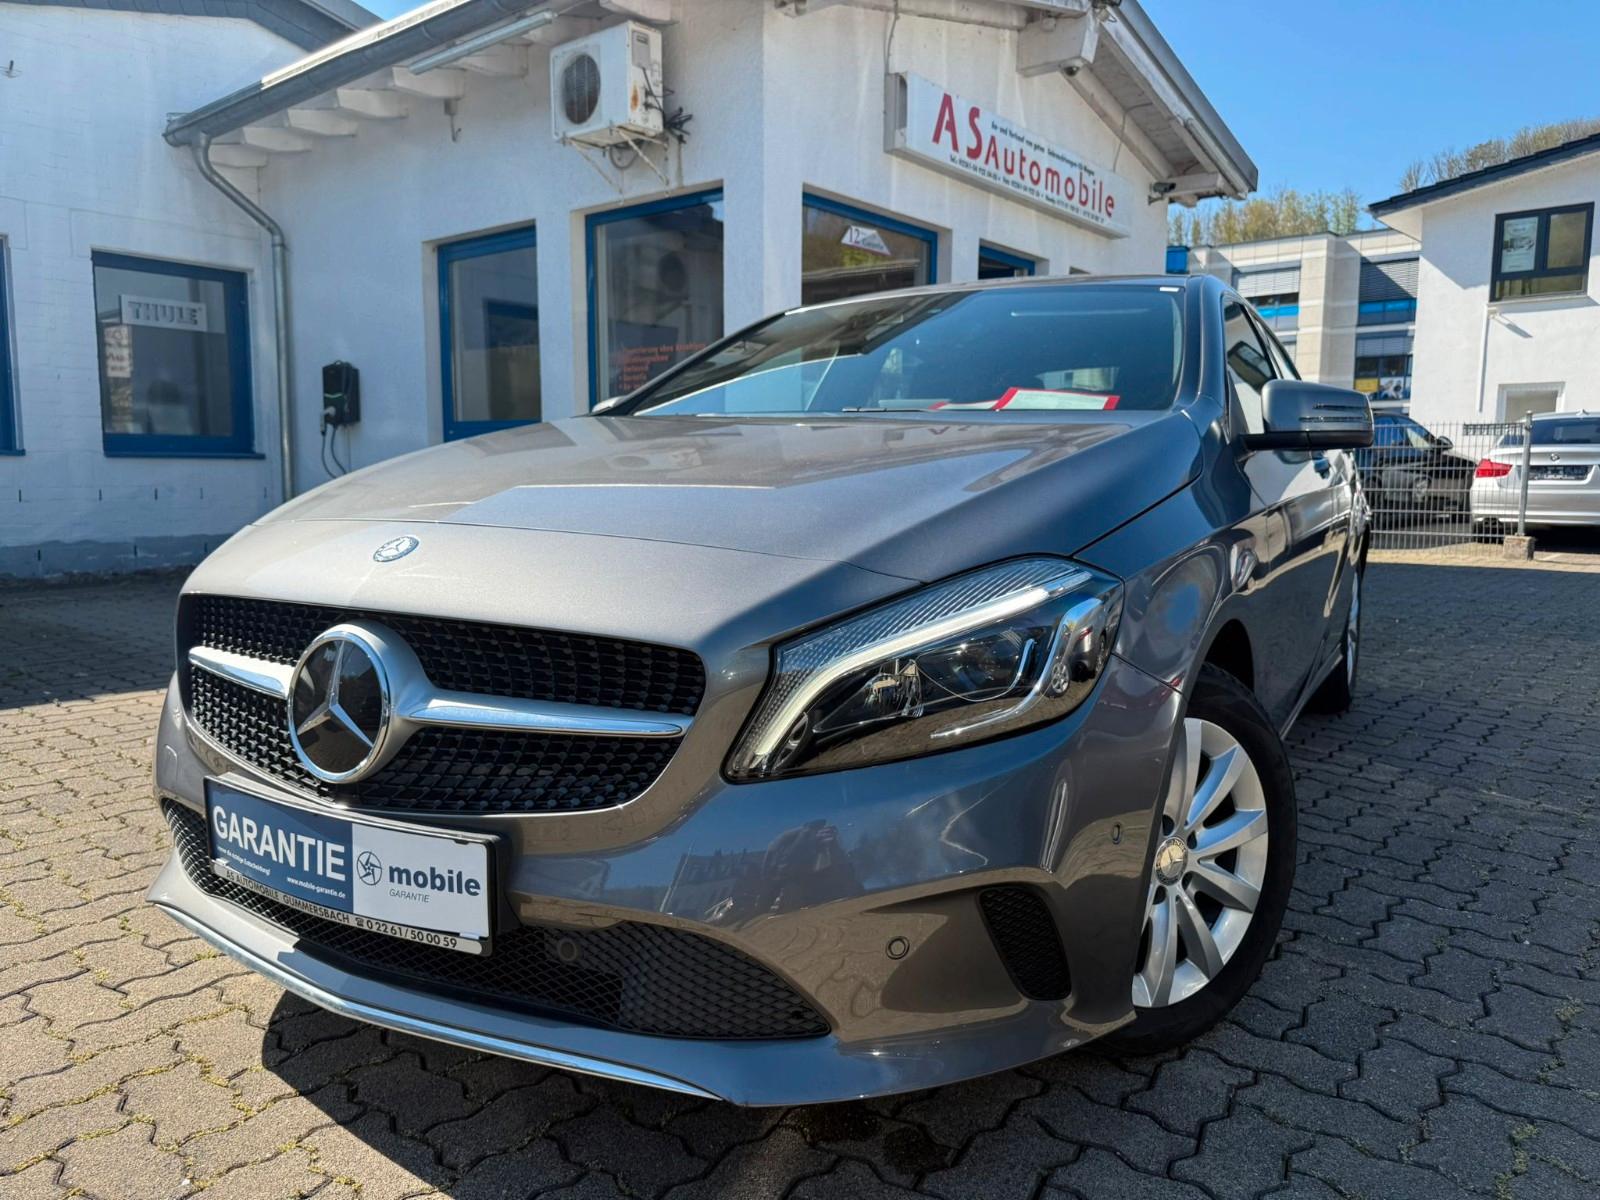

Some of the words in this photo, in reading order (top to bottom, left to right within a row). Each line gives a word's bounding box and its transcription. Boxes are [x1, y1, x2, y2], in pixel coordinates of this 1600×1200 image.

[984, 134, 1115, 218] Automobile
[213, 805, 346, 882] GARANTIE
[236, 874, 279, 899] AUTOMOBILE
[283, 894, 350, 923] GUMMERSBACH
[287, 877, 346, 899] www.mobile-garantie.de
[389, 865, 481, 896] mobile
[389, 888, 430, 903] GARANTIE
